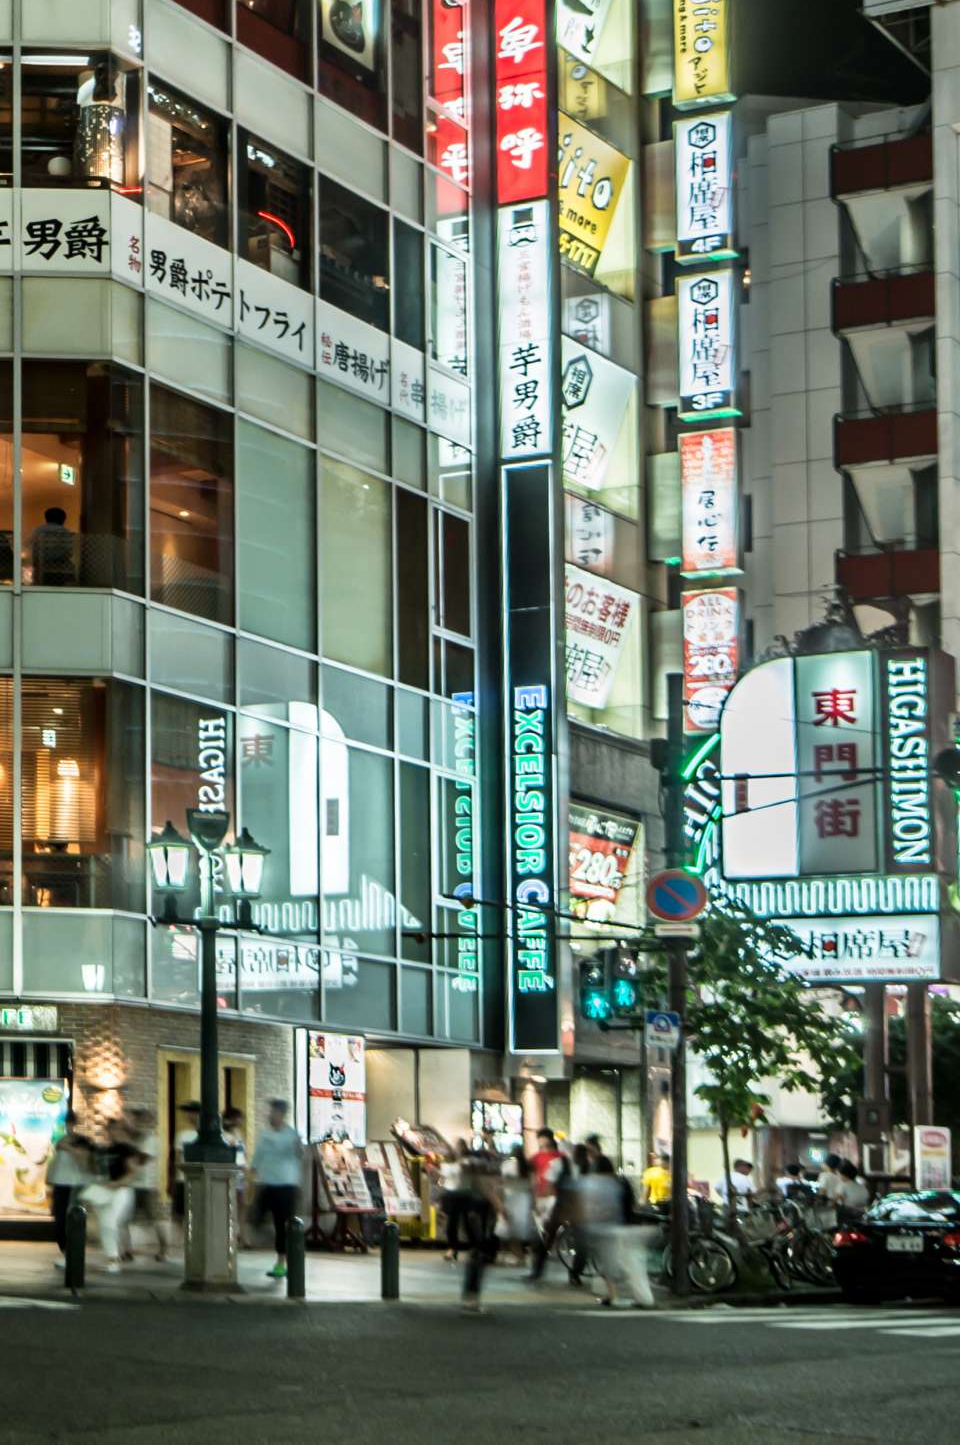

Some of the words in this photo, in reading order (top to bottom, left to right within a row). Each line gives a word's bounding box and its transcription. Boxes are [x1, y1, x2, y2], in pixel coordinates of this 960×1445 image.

[497, 16, 545, 169] 卑弥呼
[508, 343, 542, 449] 芋男爵
[513, 685, 548, 875] EXCELSIOR
[812, 688, 860, 839] 東門街
[887, 657, 930, 864] HIGASHIMON
[516, 878, 554, 994] CAFFÉ
